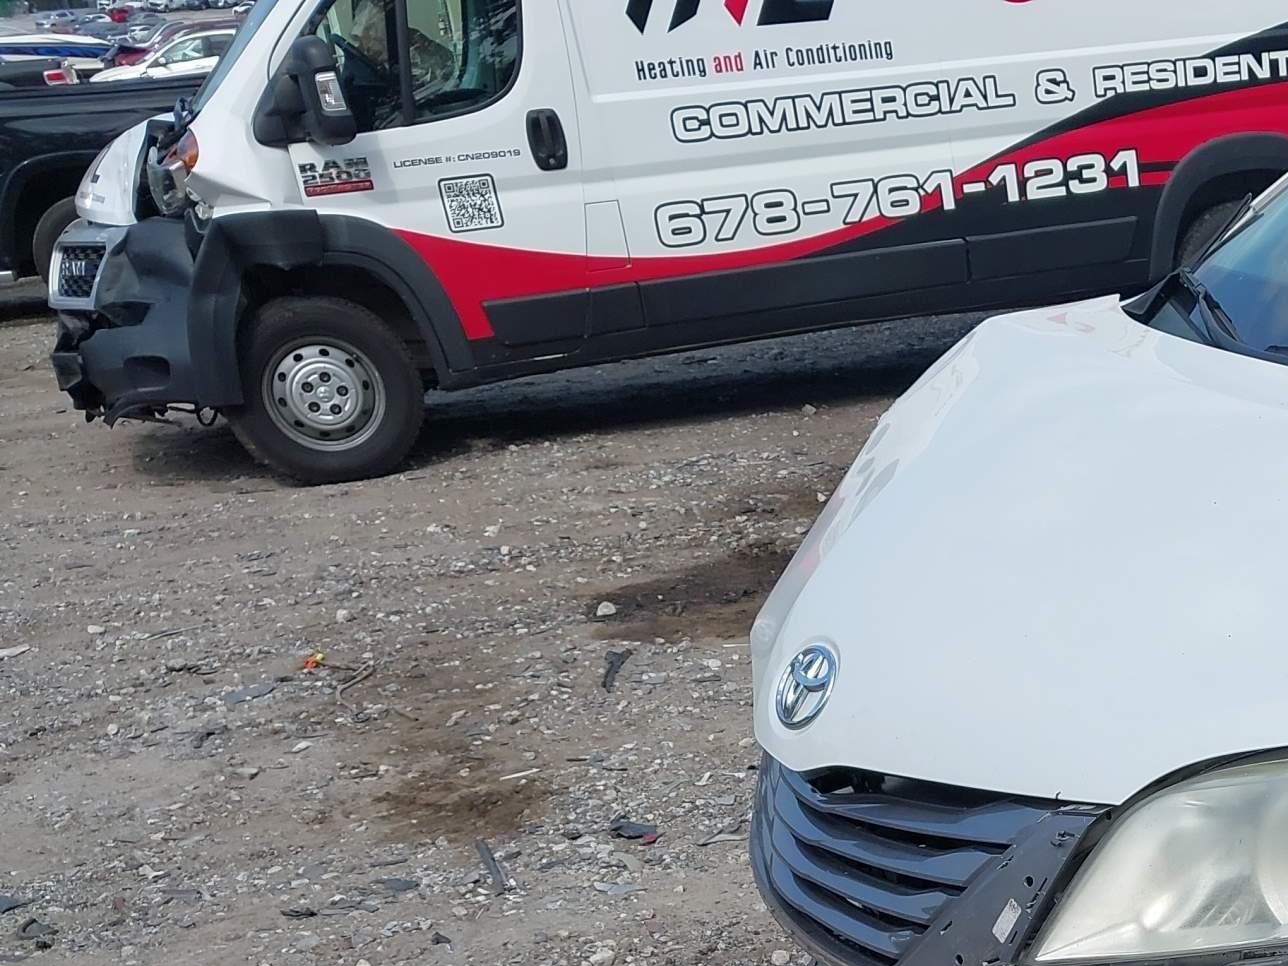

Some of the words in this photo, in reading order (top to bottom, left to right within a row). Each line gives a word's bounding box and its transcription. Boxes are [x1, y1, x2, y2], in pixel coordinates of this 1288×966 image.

[635, 57, 708, 81] Heating
[713, 52, 744, 74] and
[753, 49, 778, 71] Air
[786, 39, 894, 68] Conditioning
[670, 73, 1017, 143] COMMERCIAL
[1034, 68, 1076, 104] &
[298, 156, 368, 174] RAM
[393, 156, 443, 168] LICENSE
[457, 149, 521, 162] CN209019
[302, 169, 371, 185] 2500
[654, 149, 1140, 248] 678-761-1231
